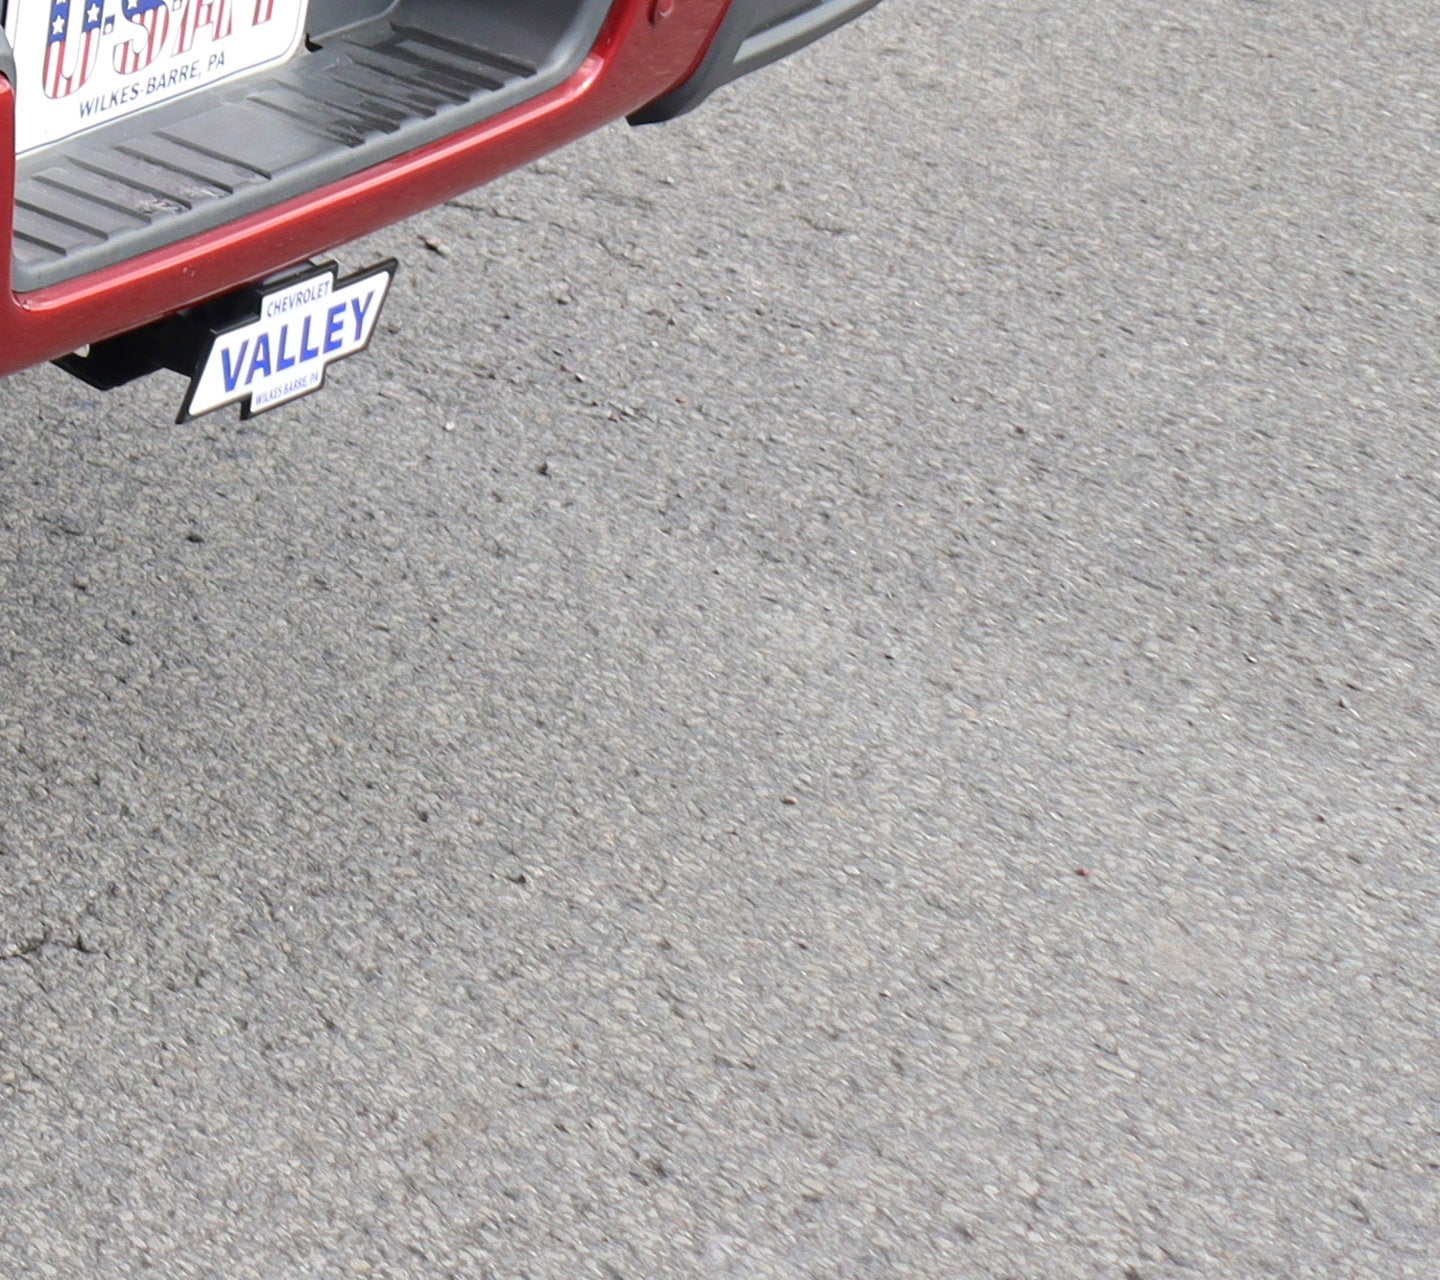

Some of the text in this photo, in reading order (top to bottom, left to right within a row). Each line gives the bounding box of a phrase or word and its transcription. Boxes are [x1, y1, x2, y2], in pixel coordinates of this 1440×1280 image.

[78, 51, 225, 119] WILKES-BARRE, PA
[267, 281, 330, 317] CHEVROLET
[221, 291, 374, 392] VALLEY
[256, 387, 283, 406] WILKES
[309, 372, 319, 383] PA
